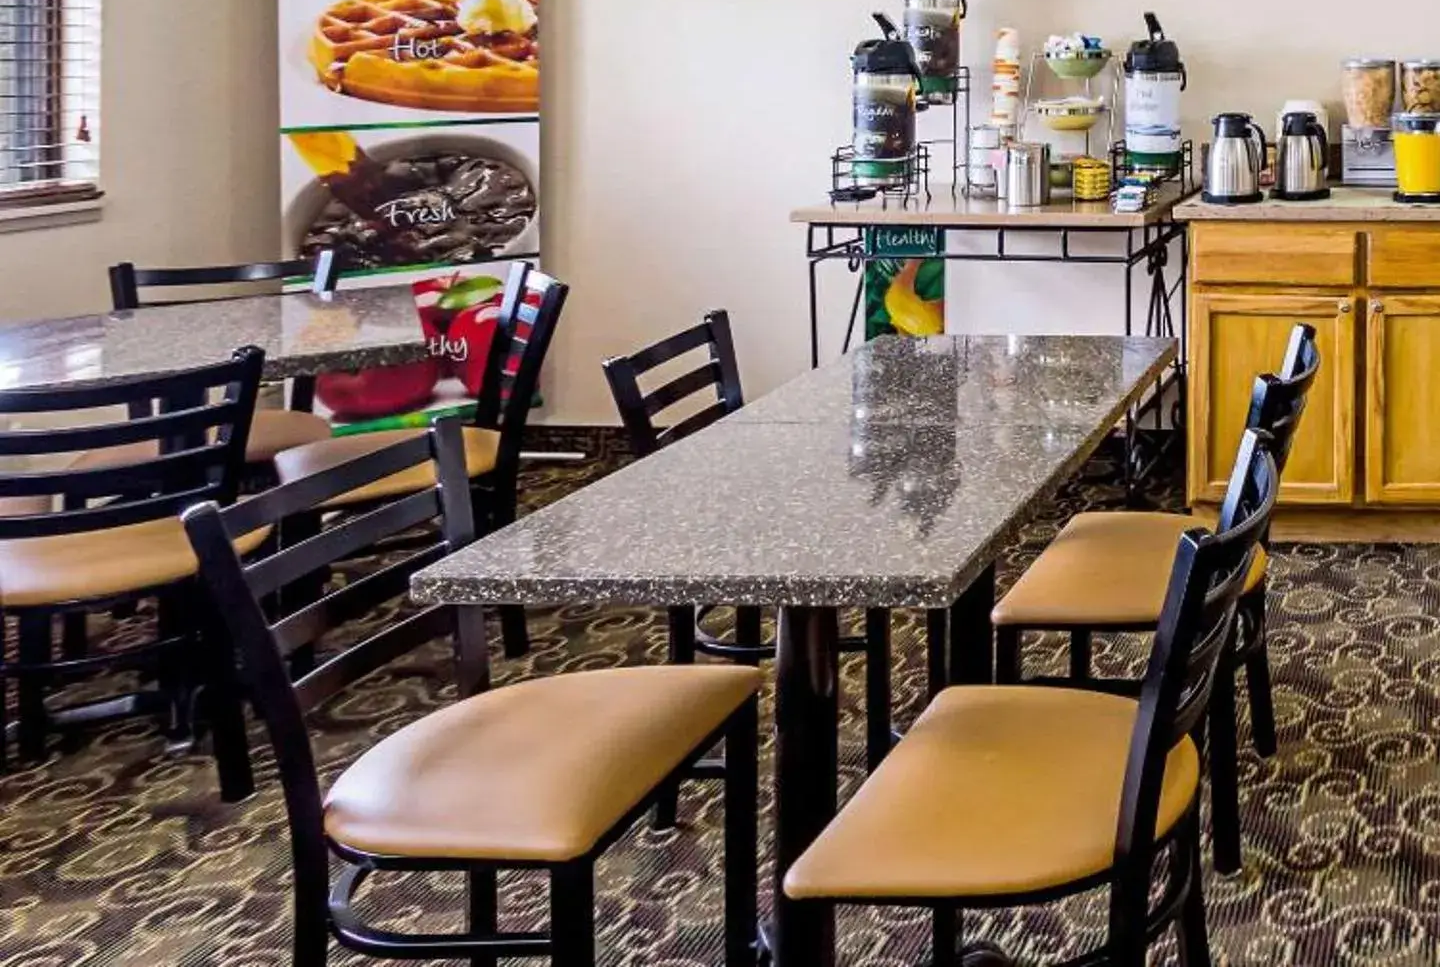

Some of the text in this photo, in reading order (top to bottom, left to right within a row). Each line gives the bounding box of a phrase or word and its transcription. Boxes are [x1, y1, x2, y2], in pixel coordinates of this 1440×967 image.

[387, 30, 438, 61] Hot
[374, 197, 457, 227] Fresh
[876, 228, 938, 250] Healthy
